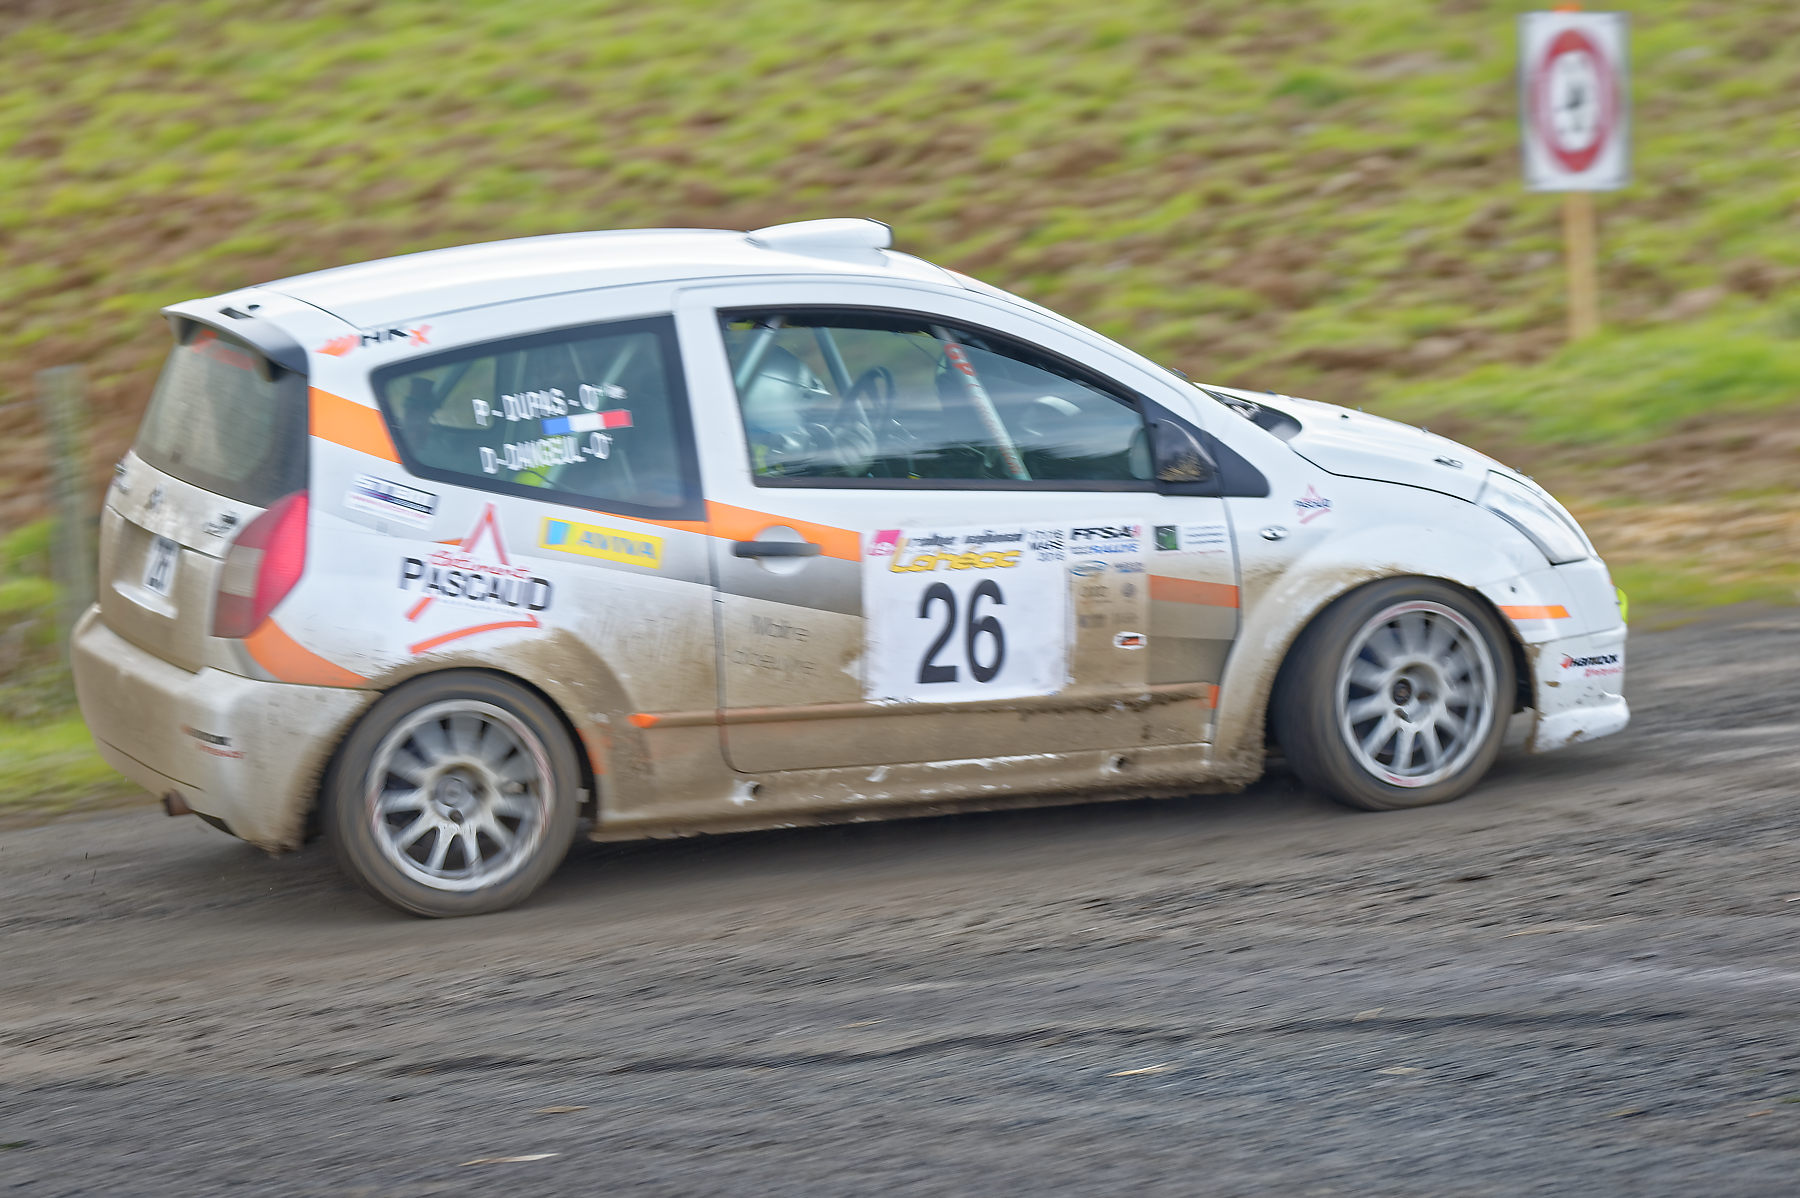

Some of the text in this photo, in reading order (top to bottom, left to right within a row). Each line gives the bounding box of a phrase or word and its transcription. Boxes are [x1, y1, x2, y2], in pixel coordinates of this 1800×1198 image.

[577, 530, 658, 560] AVIVA
[1069, 525, 1133, 541] FFSA
[398, 556, 553, 611] PASCAUD
[916, 578, 1006, 684] 26
